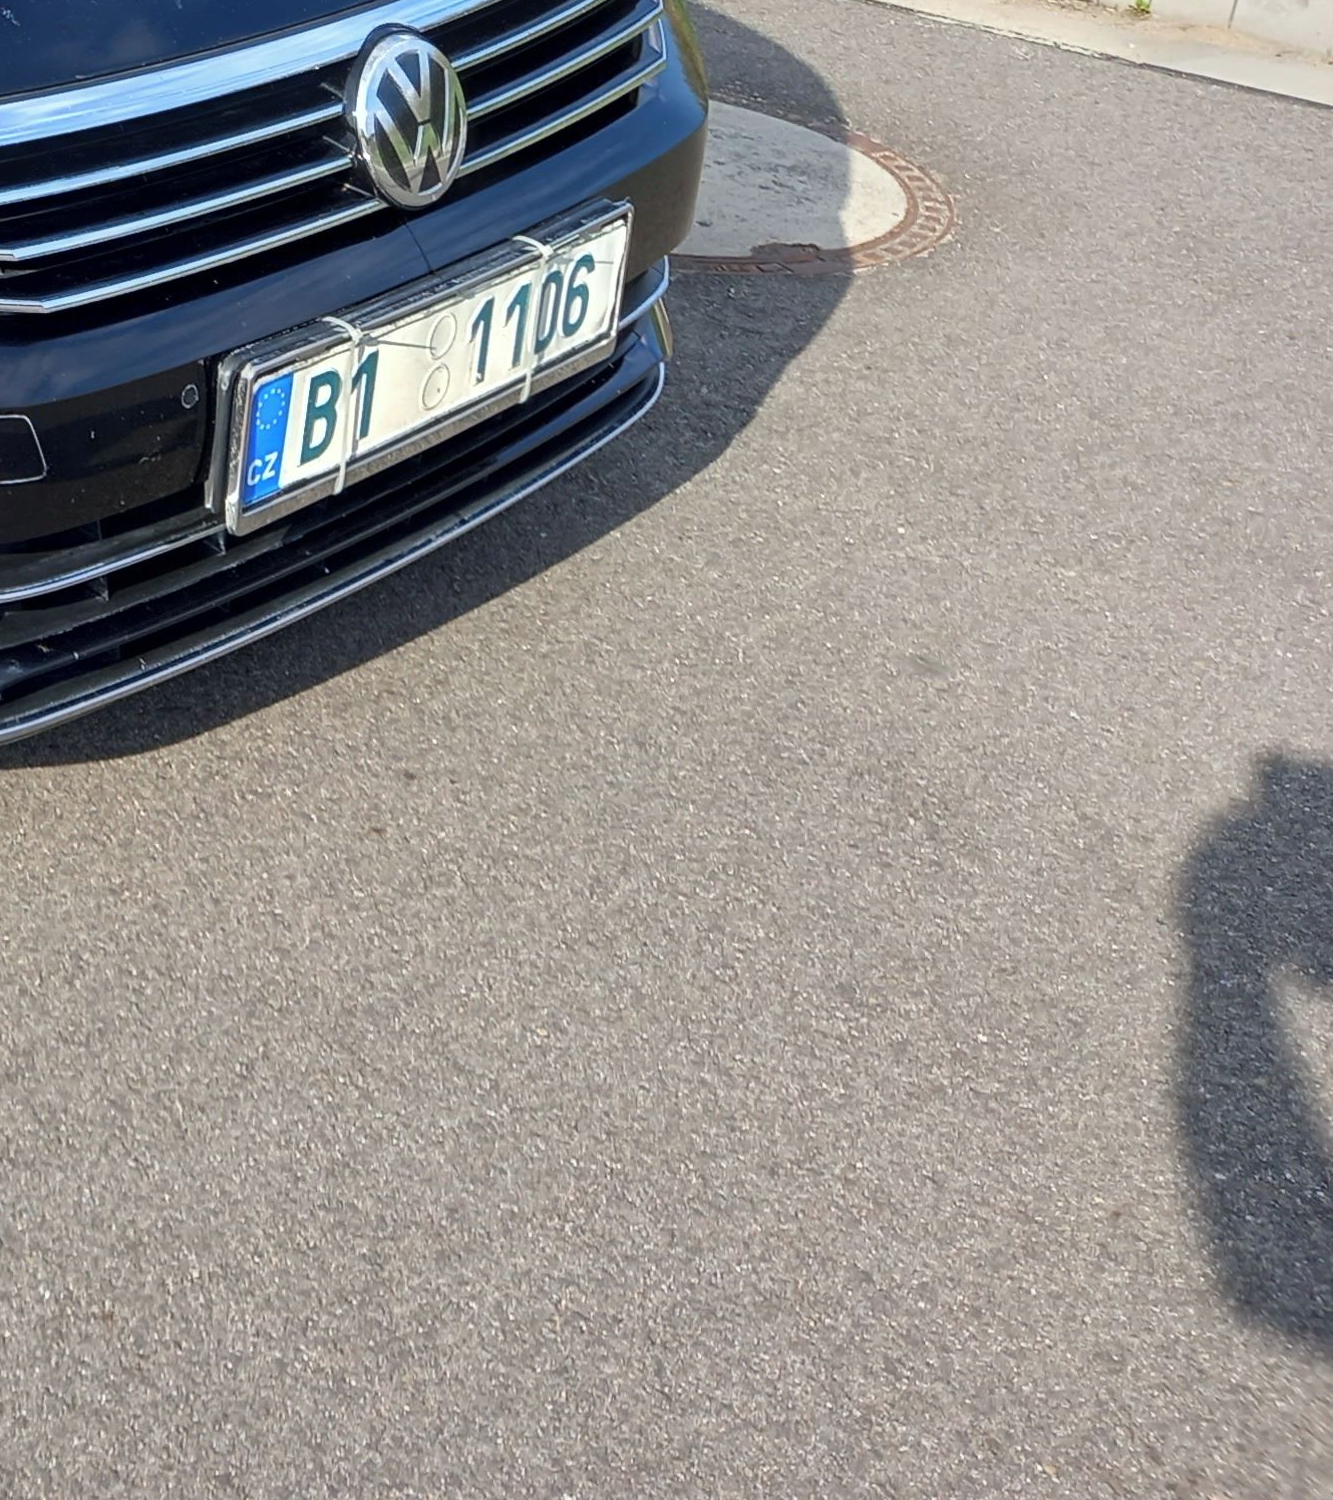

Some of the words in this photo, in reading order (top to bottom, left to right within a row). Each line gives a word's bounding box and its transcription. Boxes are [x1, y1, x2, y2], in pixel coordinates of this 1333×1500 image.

[365, 45, 465, 198] VW
[298, 348, 379, 467] B1
[470, 253, 595, 386] 1106
[247, 451, 276, 486] CZ
